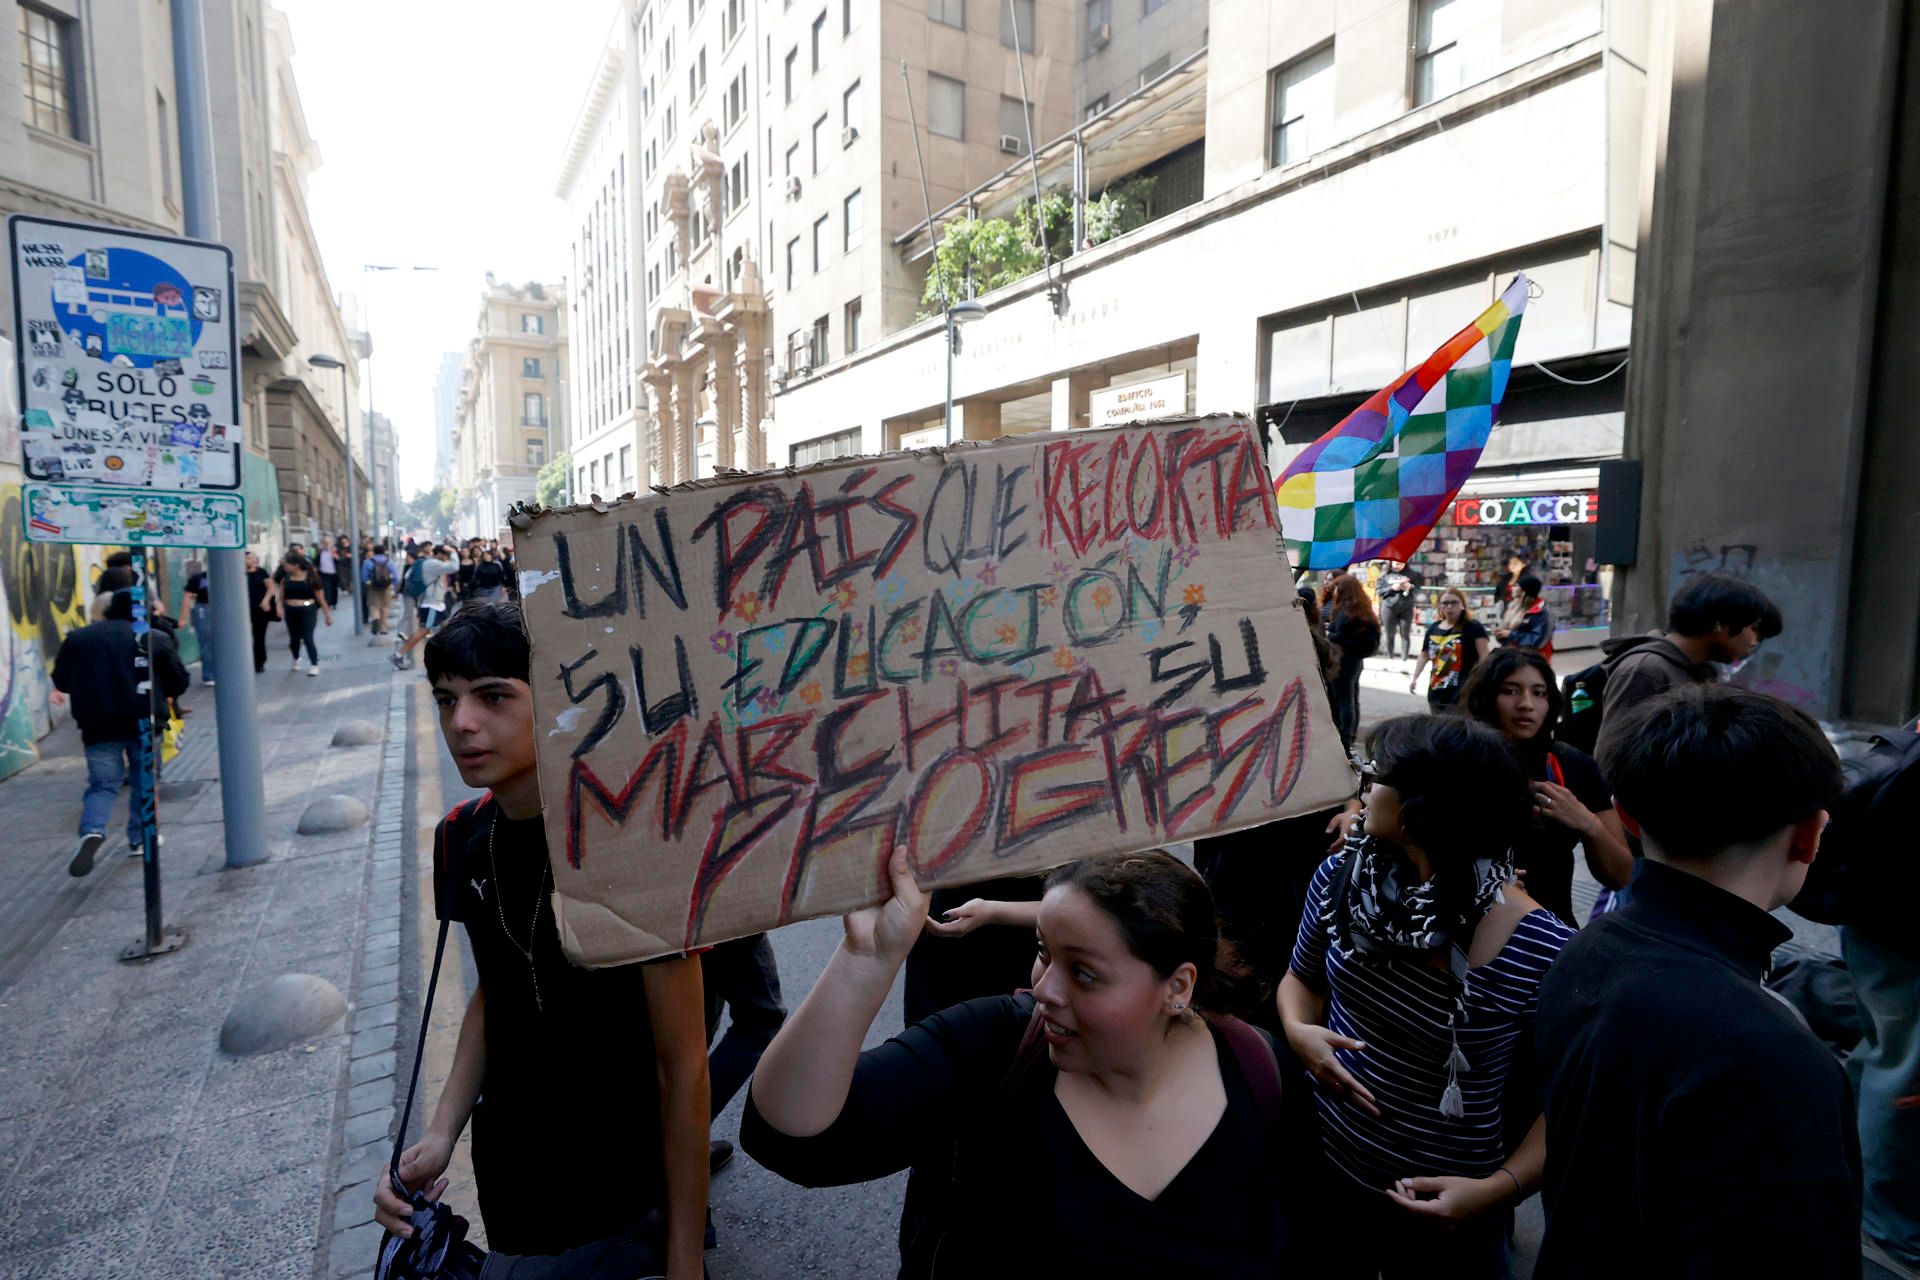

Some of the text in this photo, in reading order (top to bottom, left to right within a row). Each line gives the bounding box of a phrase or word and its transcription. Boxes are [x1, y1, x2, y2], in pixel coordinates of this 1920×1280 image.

[97, 371, 176, 397] SOLO
[120, 431, 133, 443] A
[553, 423, 1283, 624] UN PAÍS QUE RECORTA
[556, 634, 700, 760] SU
[566, 616, 1269, 869] MARCHITA SU
[683, 675, 1312, 954] PROGRESO
